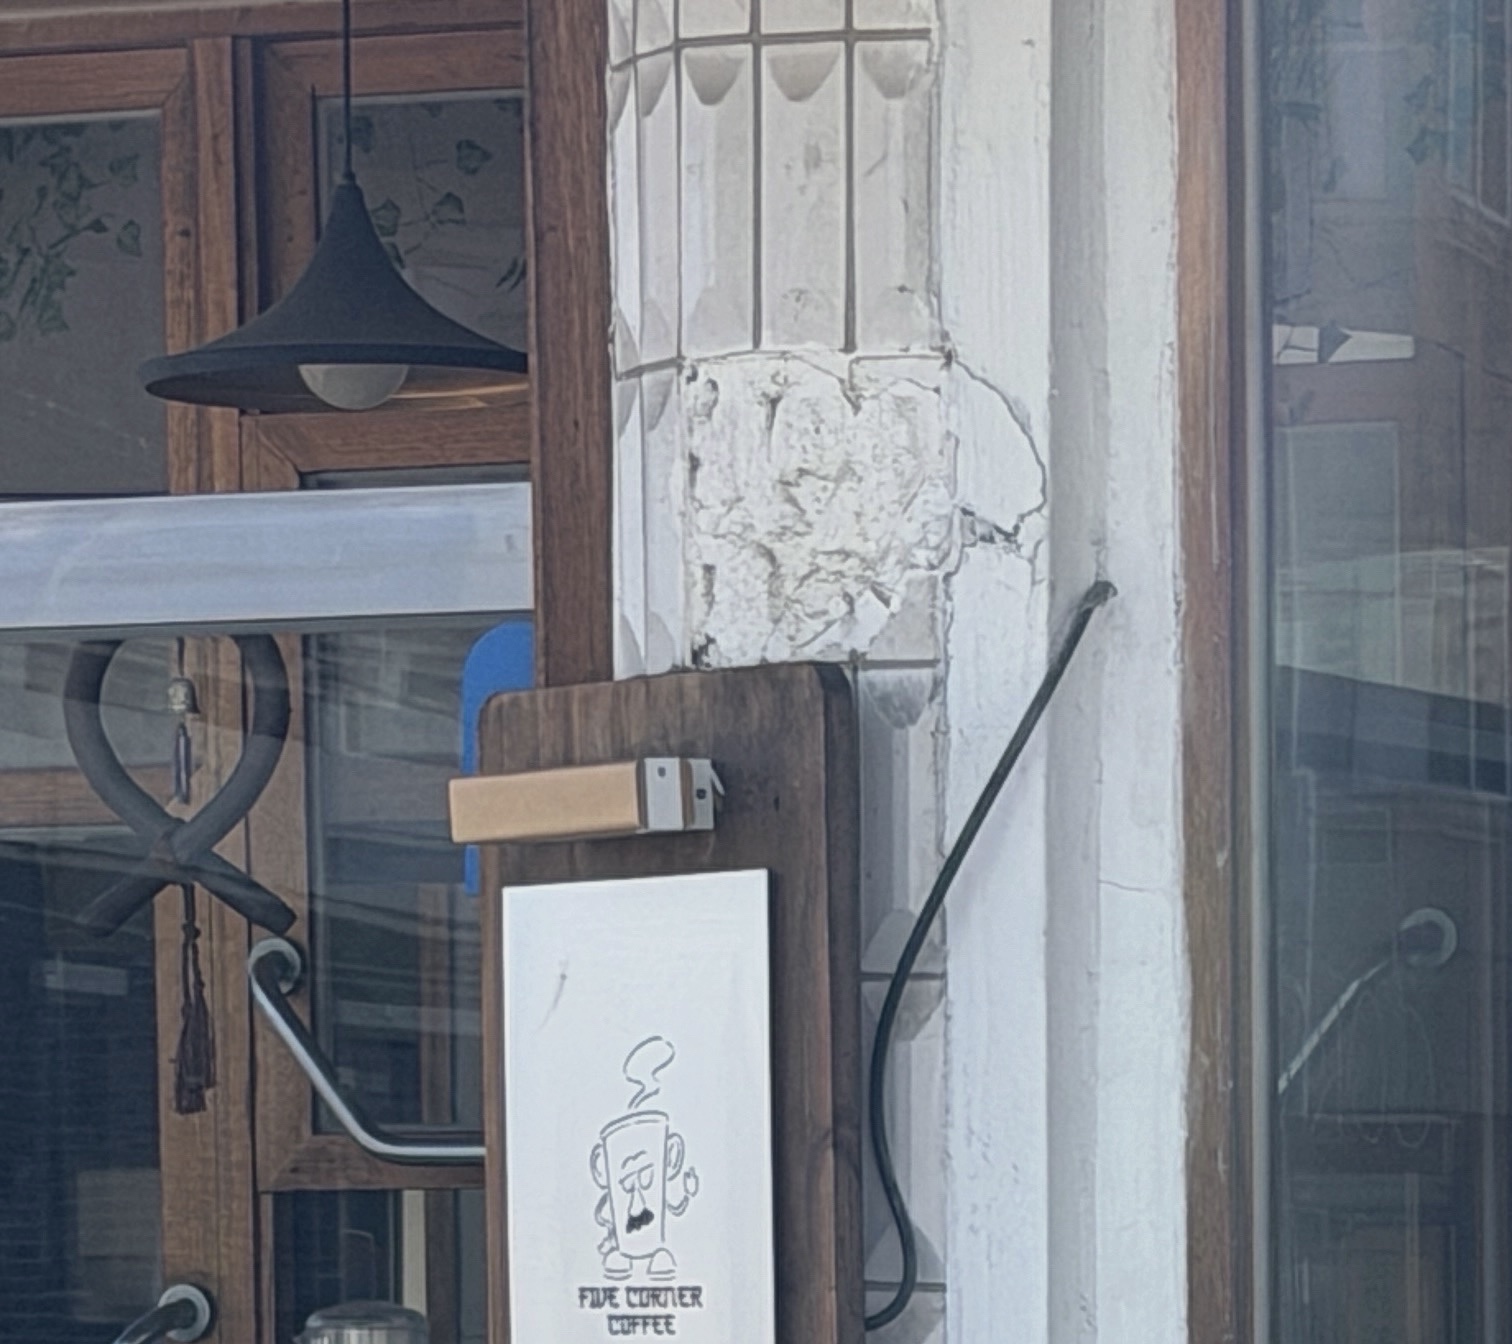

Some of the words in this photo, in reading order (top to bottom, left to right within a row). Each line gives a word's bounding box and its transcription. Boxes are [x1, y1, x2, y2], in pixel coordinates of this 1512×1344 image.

[578, 1286, 620, 1308] FIVE
[625, 1286, 703, 1308] CORNER
[607, 1314, 676, 1335] COFFEE
